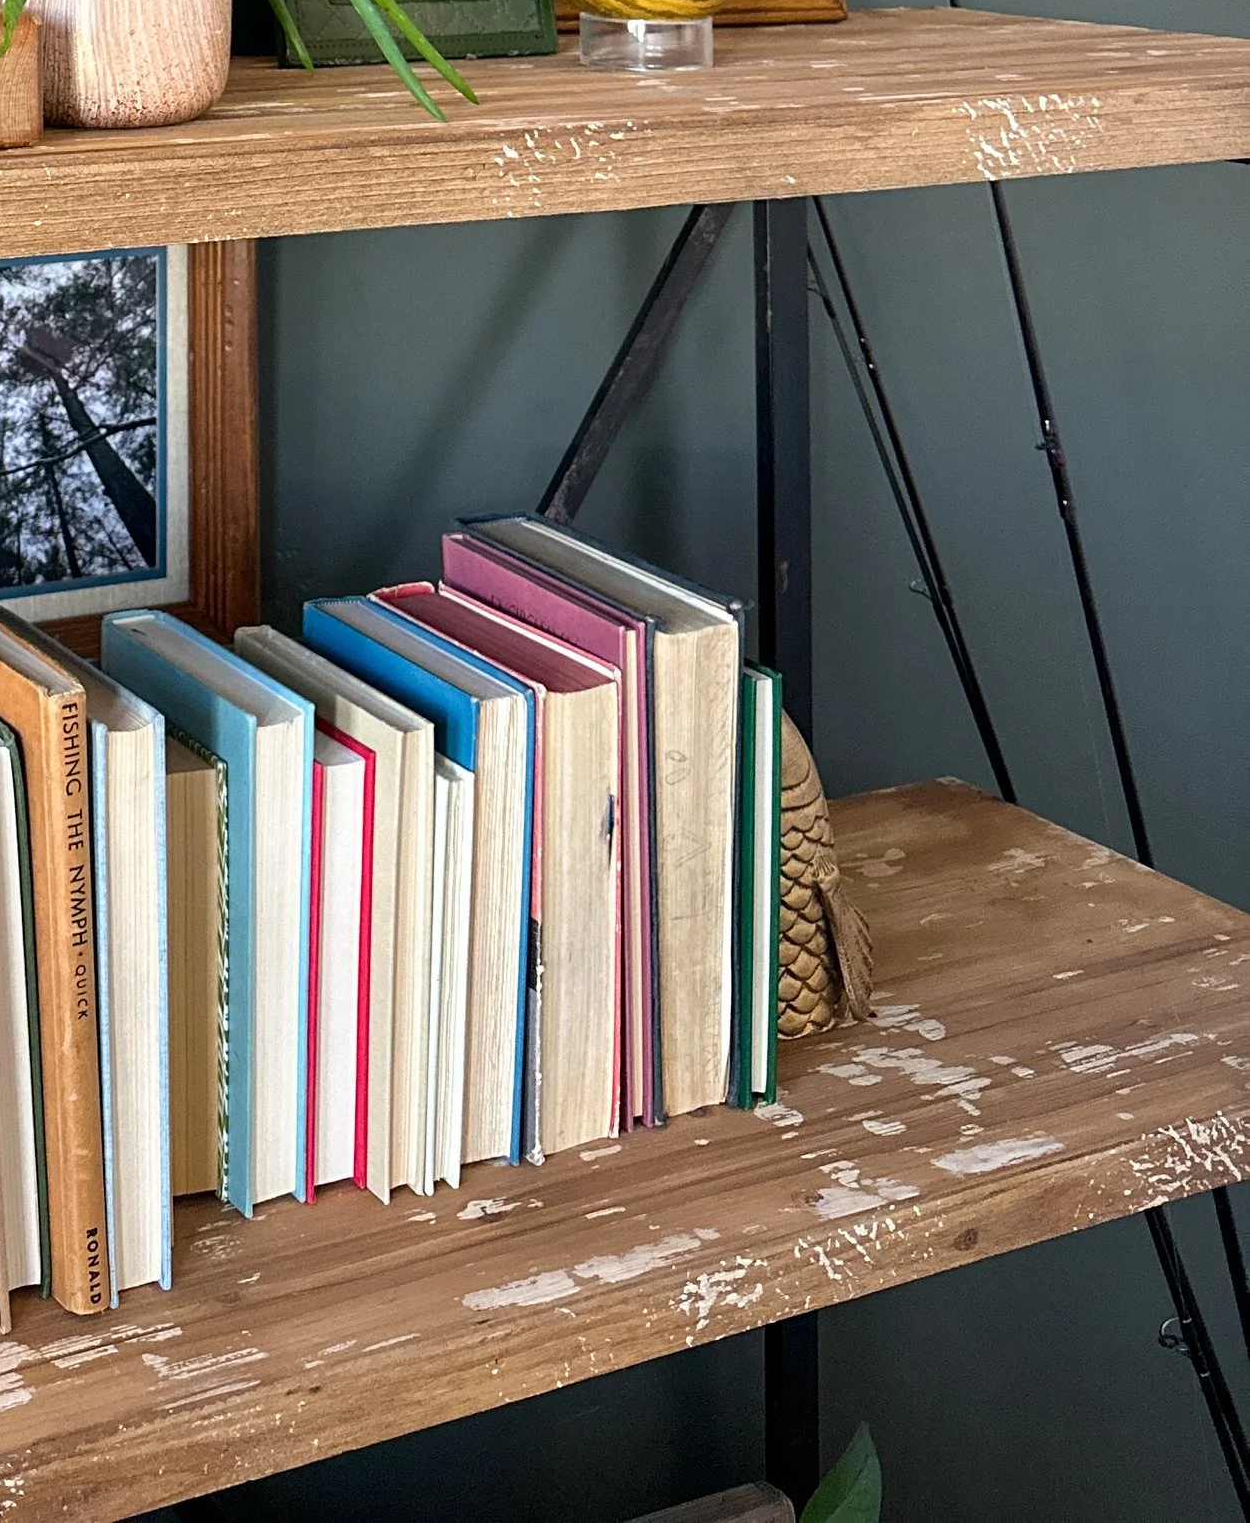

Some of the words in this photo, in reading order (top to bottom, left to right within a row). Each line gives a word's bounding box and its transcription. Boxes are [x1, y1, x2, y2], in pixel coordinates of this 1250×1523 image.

[61, 702, 82, 797] FISHING
[67, 808, 84, 851] THE
[69, 864, 88, 947] NYMPH
[74, 964, 89, 1020] QUICK
[86, 1227, 102, 1305] RONALD
